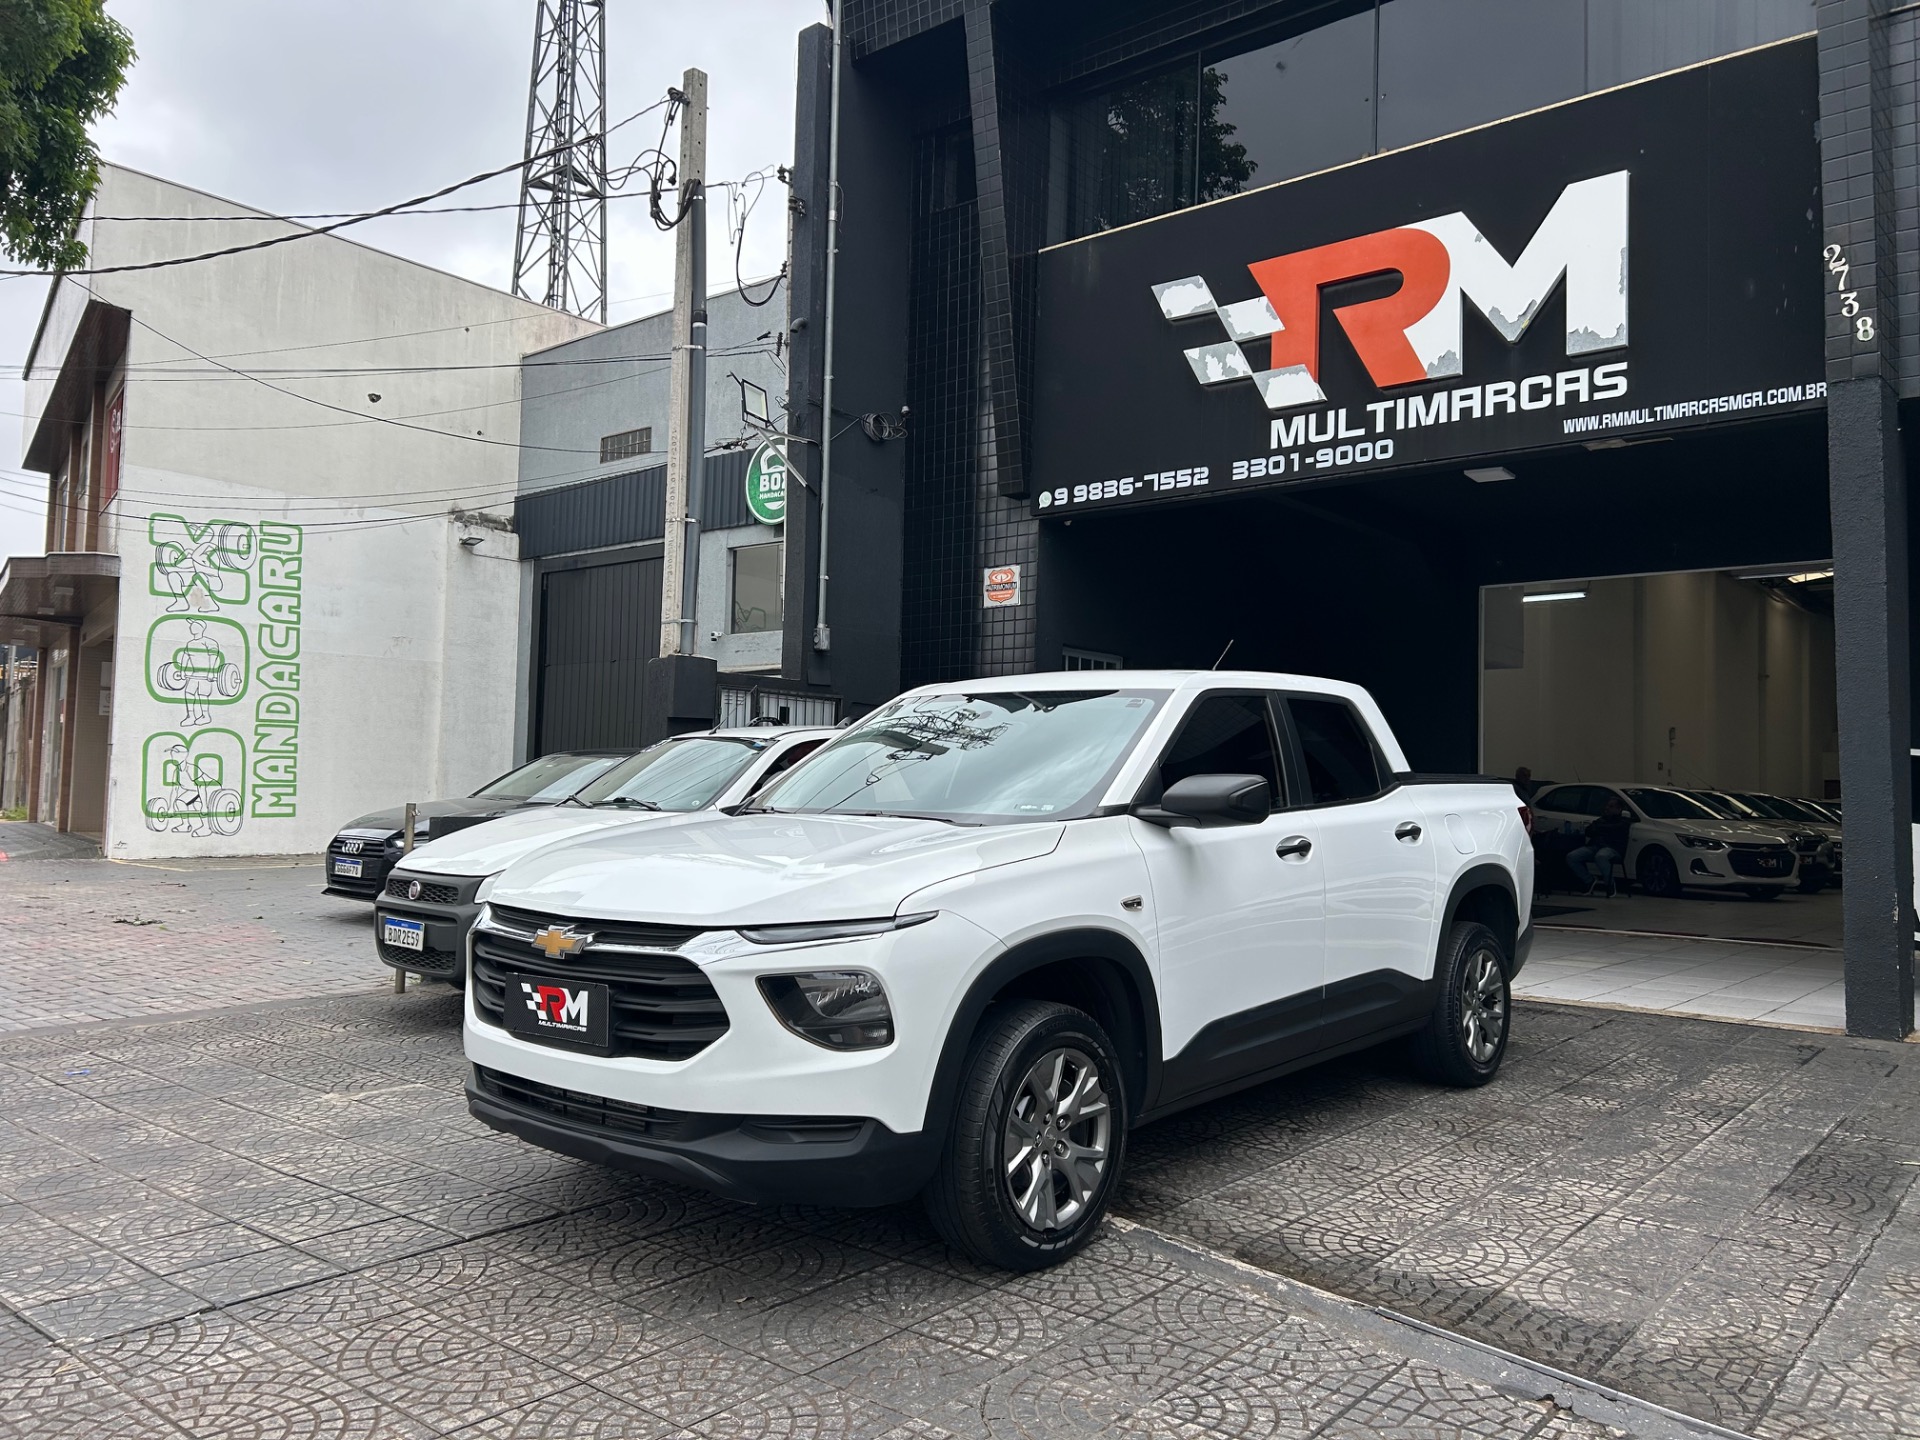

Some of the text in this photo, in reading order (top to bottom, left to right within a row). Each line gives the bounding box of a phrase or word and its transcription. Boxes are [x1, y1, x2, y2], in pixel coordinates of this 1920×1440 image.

[1247, 169, 1630, 389] RM
[1823, 244, 1875, 342] 2738
[1269, 362, 1629, 450] MULTIMARCAS
[1562, 381, 1828, 434] WWW.RMMULTIMARCASMGA.COM.BR
[758, 491, 785, 501] MANDACA
[1053, 438, 1395, 507] 9 9836-7552 3301-9000
[251, 520, 304, 819] MANDACARU
[388, 927, 420, 948] BDR2E59
[536, 985, 589, 1027] RM
[538, 1020, 588, 1033] MULTIMARCAS
